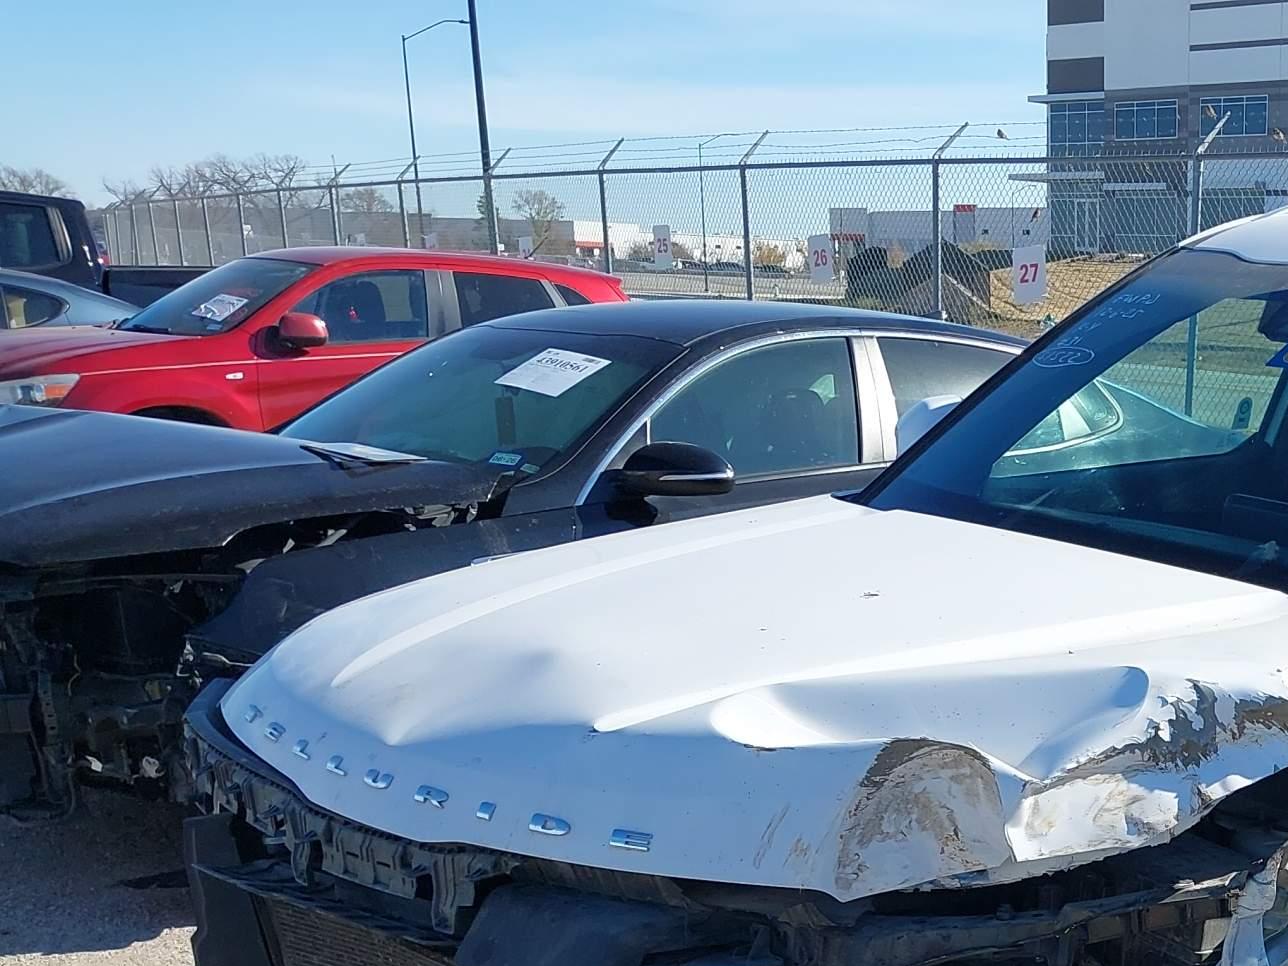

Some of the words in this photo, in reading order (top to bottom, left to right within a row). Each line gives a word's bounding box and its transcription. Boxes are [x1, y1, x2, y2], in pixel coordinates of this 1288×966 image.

[656, 238, 669, 254] 25
[813, 249, 828, 267] 26
[1018, 263, 1039, 284] 27
[537, 357, 589, 373] 43910561
[243, 703, 655, 853] TELLURIDE
